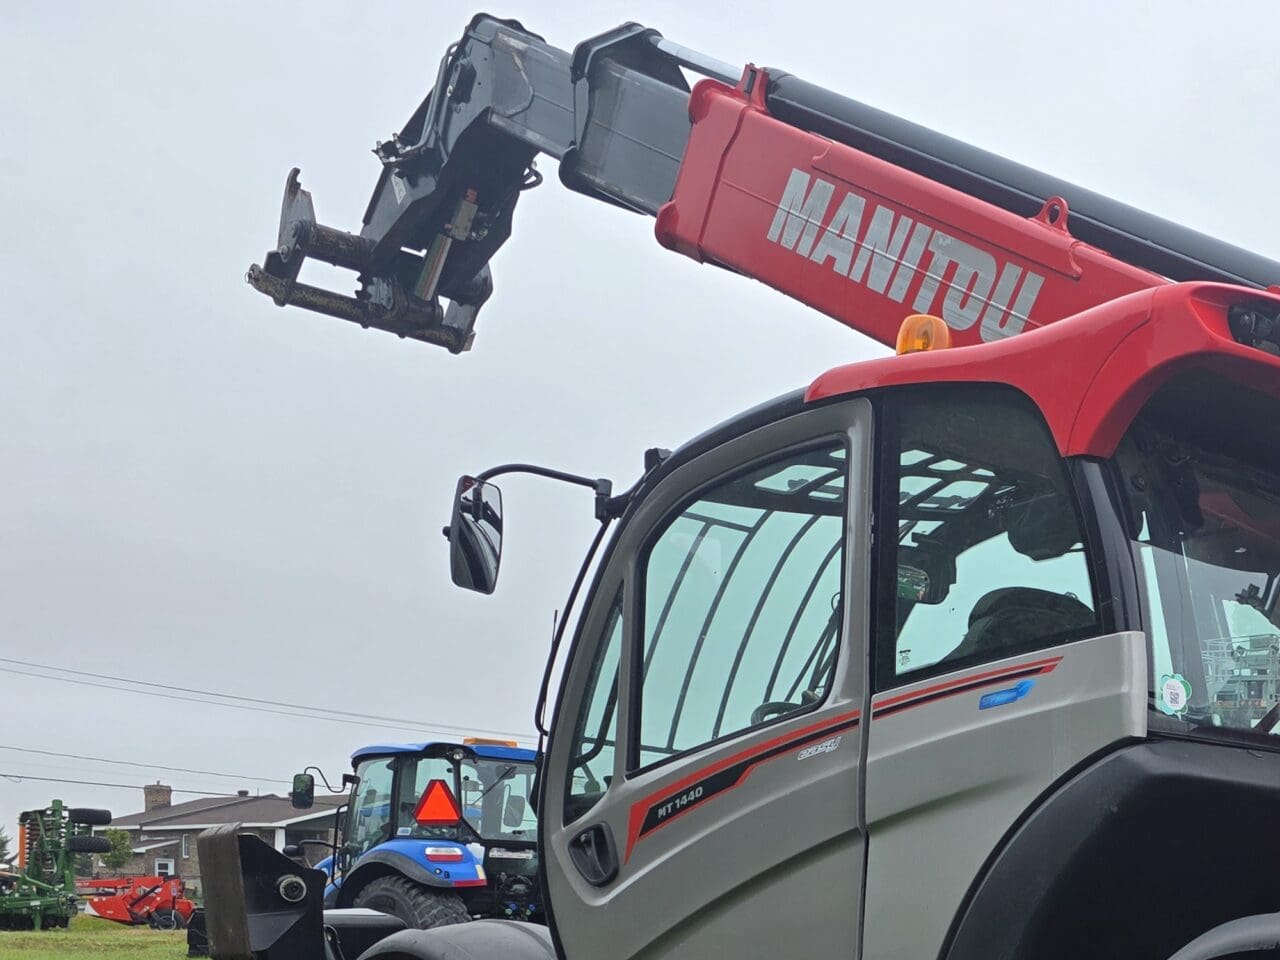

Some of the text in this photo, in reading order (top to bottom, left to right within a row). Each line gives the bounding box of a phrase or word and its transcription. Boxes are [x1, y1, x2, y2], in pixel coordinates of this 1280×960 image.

[767, 168, 1045, 342] MANITOU
[657, 787, 703, 818] MT 1440
